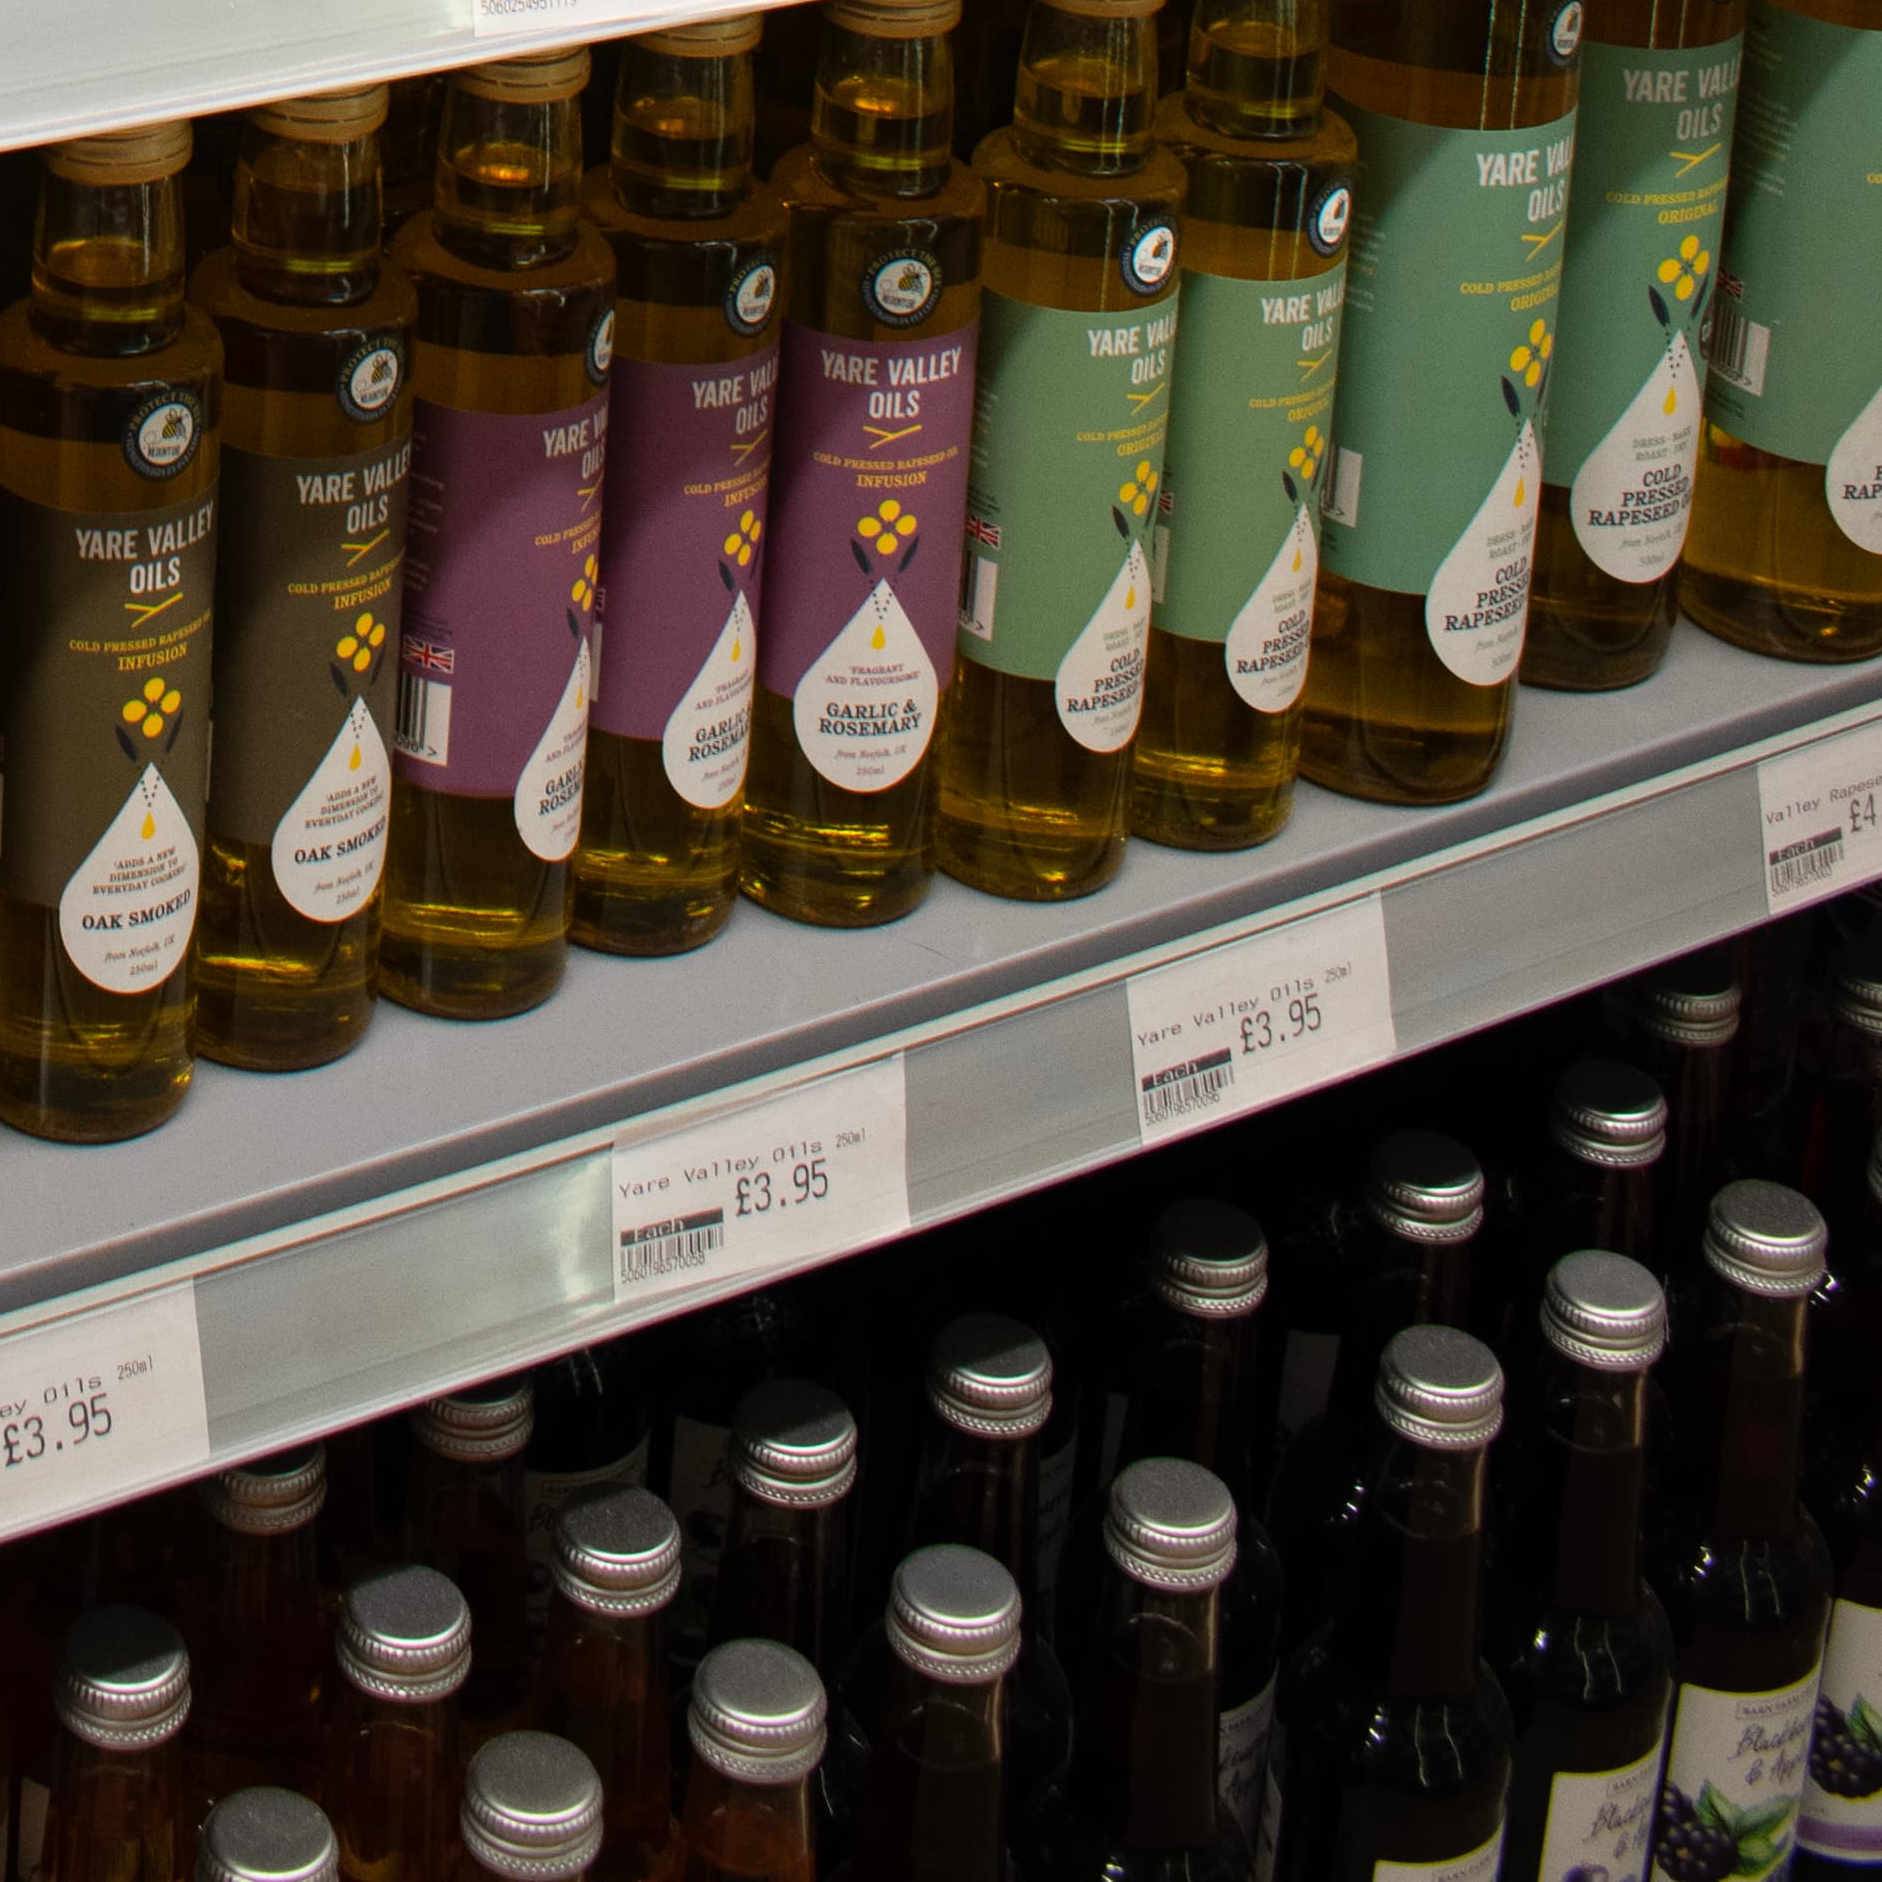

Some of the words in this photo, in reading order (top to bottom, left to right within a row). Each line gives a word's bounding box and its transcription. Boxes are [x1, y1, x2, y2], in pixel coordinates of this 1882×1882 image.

[1622, 67, 1688, 103] YARE
[1677, 106, 1722, 141] OILS
[818, 713, 922, 737] ROSEMARY
[82, 913, 123, 930] OAK
[129, 889, 191, 926] SMOKED
[1240, 993, 1321, 1055] £3.95
[735, 1158, 828, 1217] £3.95
[3, 1393, 112, 1468] £3.95
